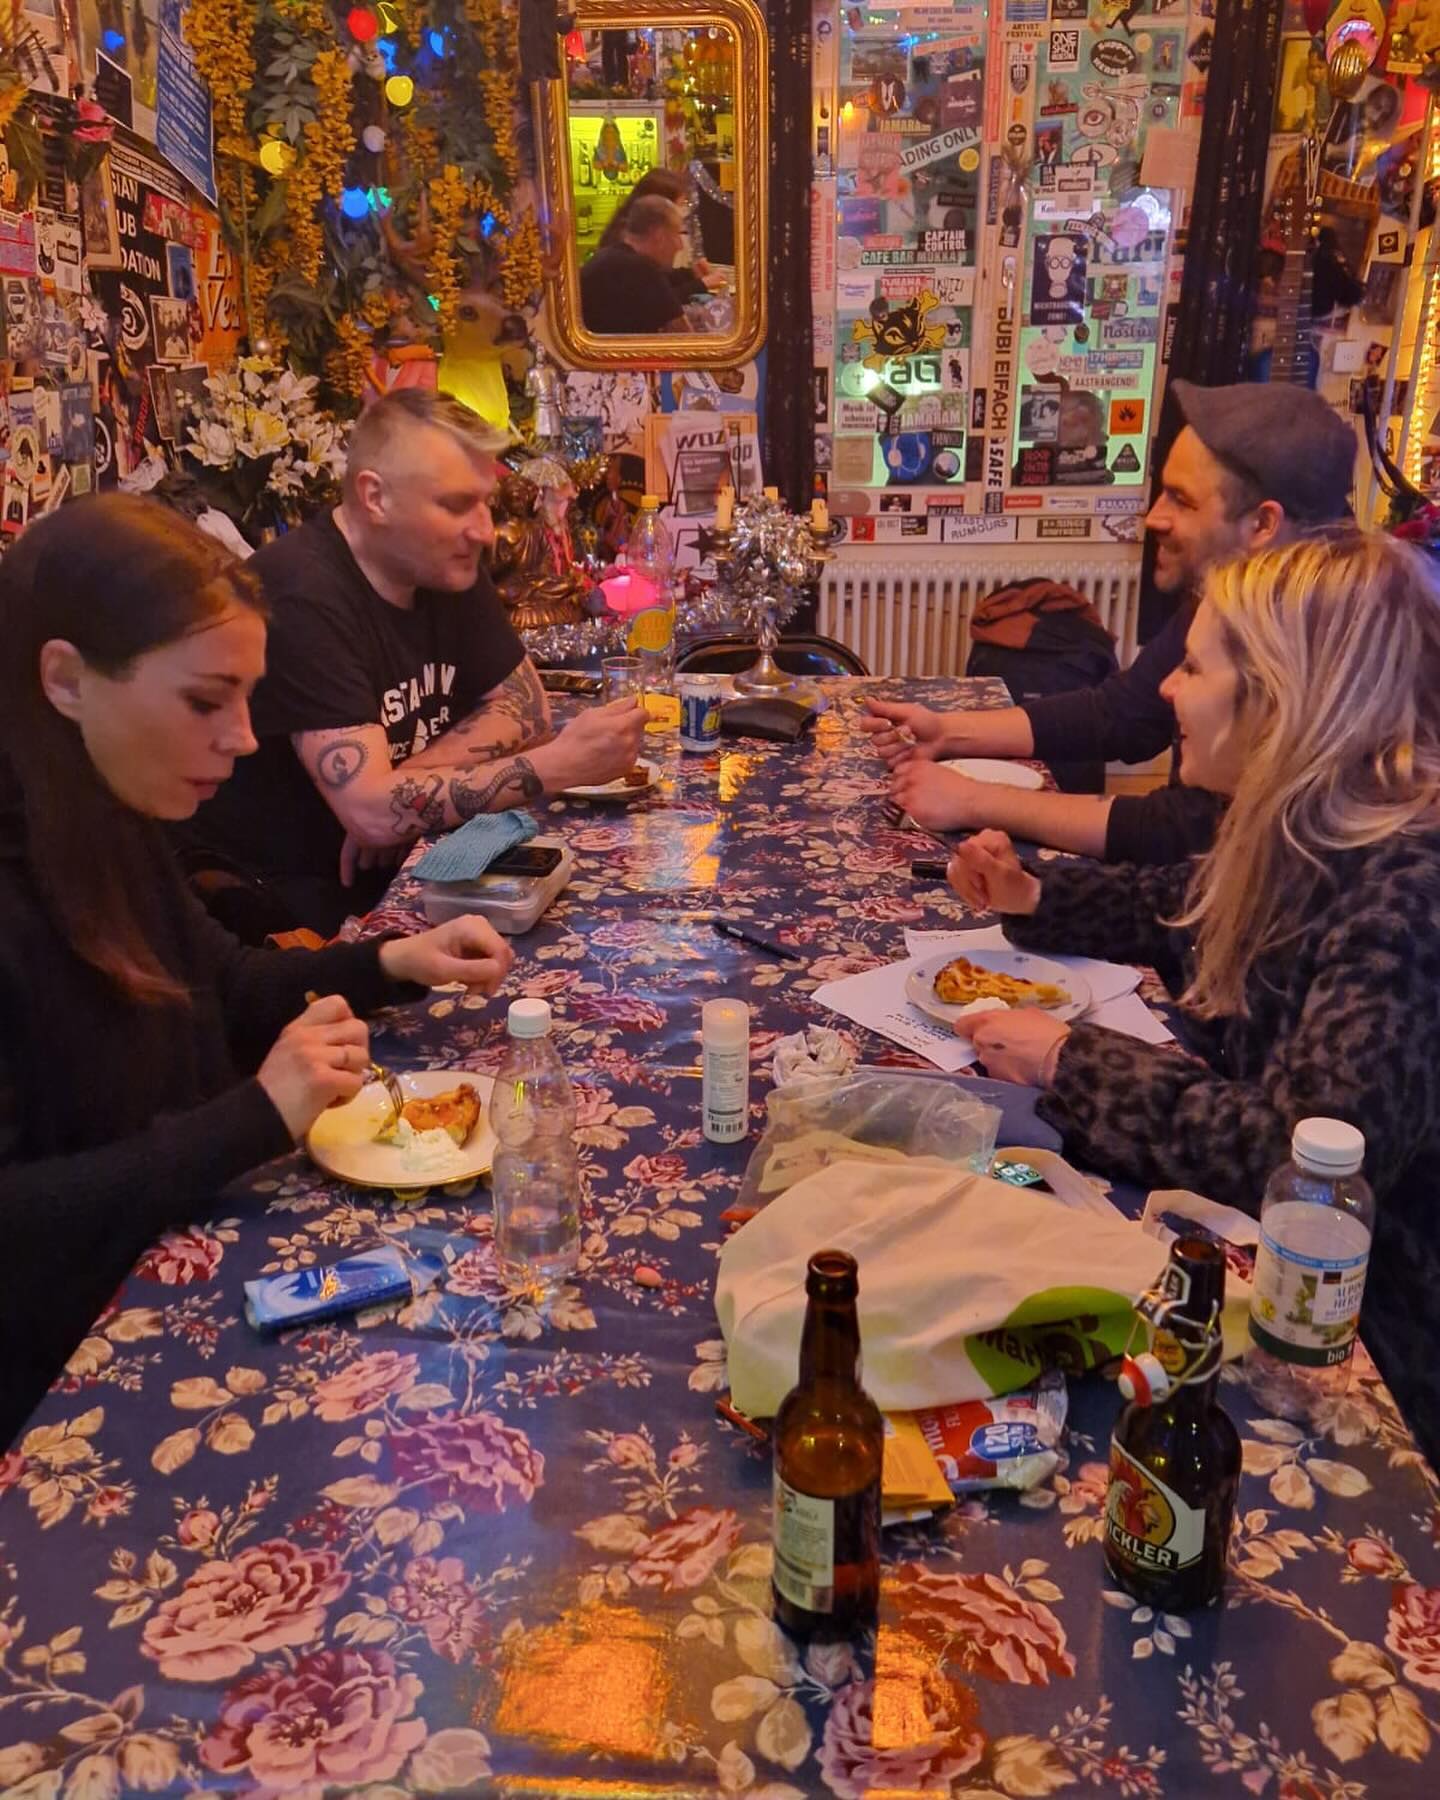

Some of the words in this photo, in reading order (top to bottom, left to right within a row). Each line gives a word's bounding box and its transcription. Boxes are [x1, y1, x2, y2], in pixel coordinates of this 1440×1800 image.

[1052, 32, 1077, 44] ONE
[1052, 42, 1077, 54] SHOT
[944, 127, 979, 148] ONLY
[925, 230, 966, 241] CAPTAIN
[925, 239, 967, 252] CONTROL
[862, 251, 891, 264] CAFE
[892, 251, 914, 263] BAR
[991, 360, 1011, 430] EIFACH
[988, 447, 1005, 487] SAFE
[951, 518, 1009, 539] RUMOURS
[985, 1424, 1010, 1453] 120
